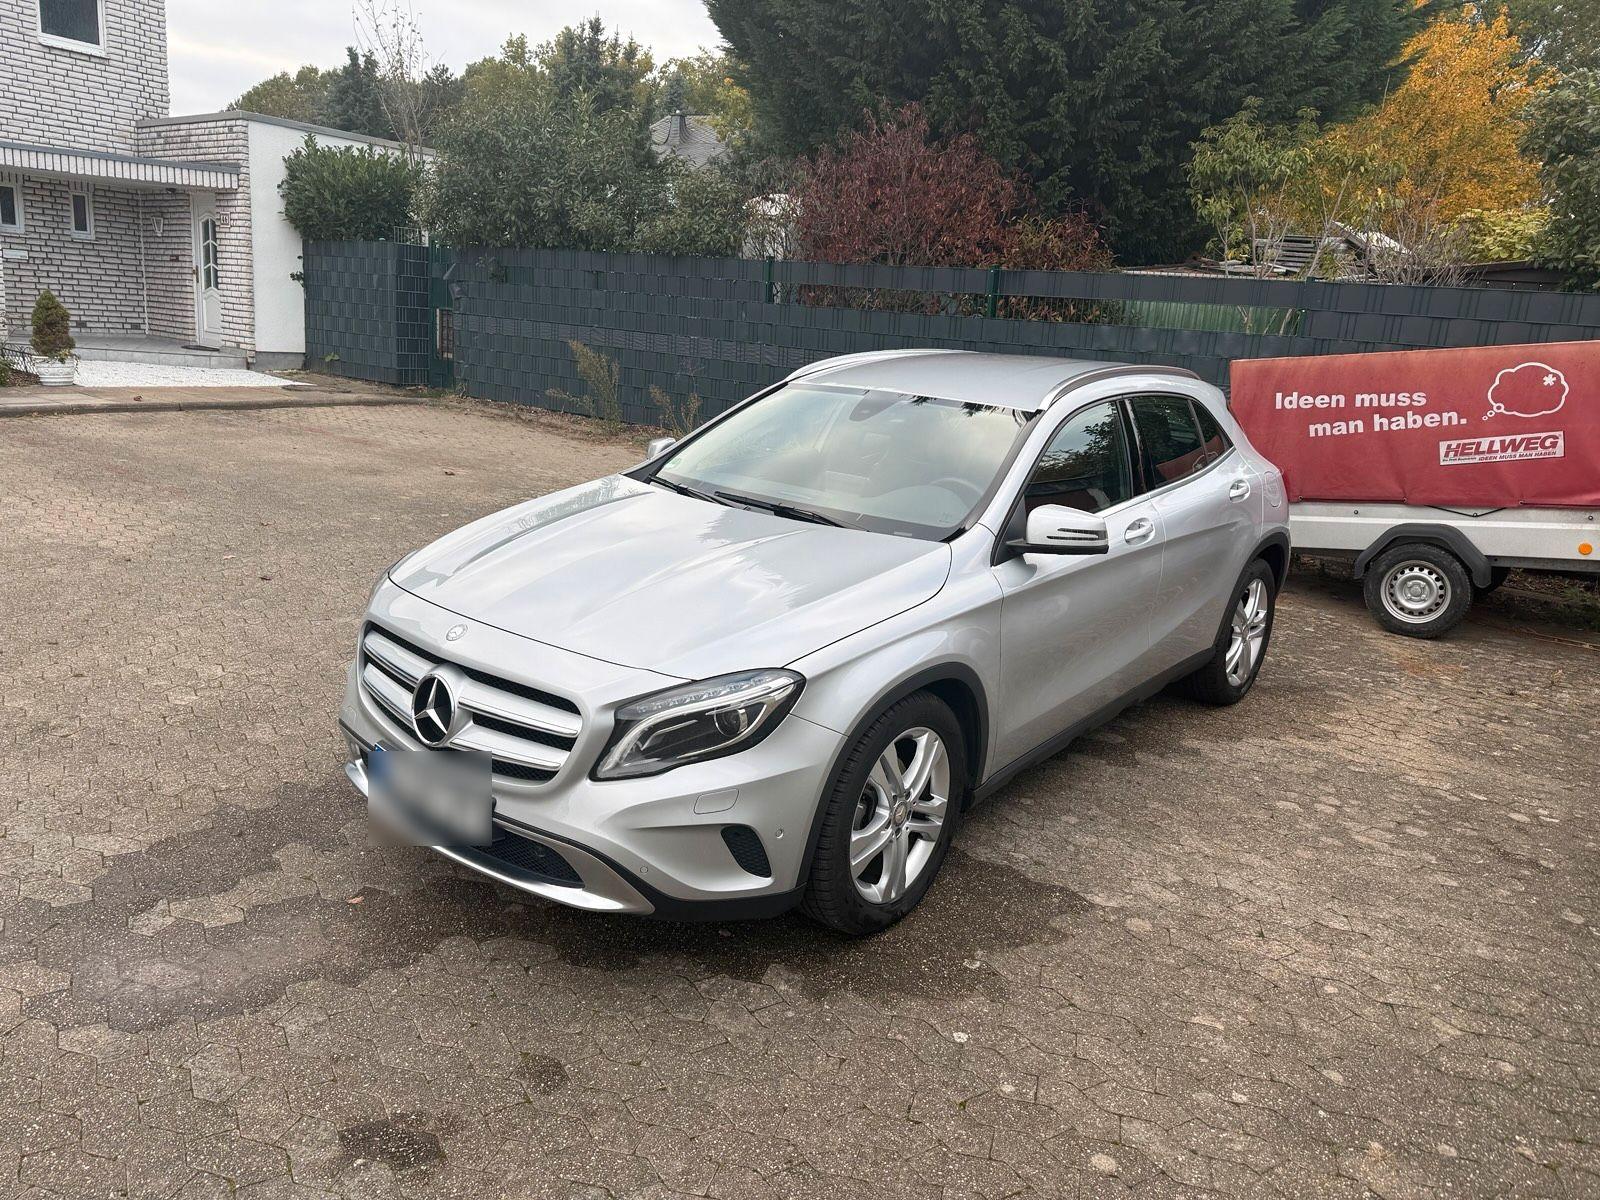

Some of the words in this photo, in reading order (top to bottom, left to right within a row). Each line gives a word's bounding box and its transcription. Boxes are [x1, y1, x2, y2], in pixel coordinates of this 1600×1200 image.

[1275, 392, 1345, 409] Ideen
[1355, 391, 1427, 407] muss
[1309, 419, 1364, 437] man
[1373, 411, 1467, 431] haben.
[1443, 435, 1559, 458] HELLWEG
